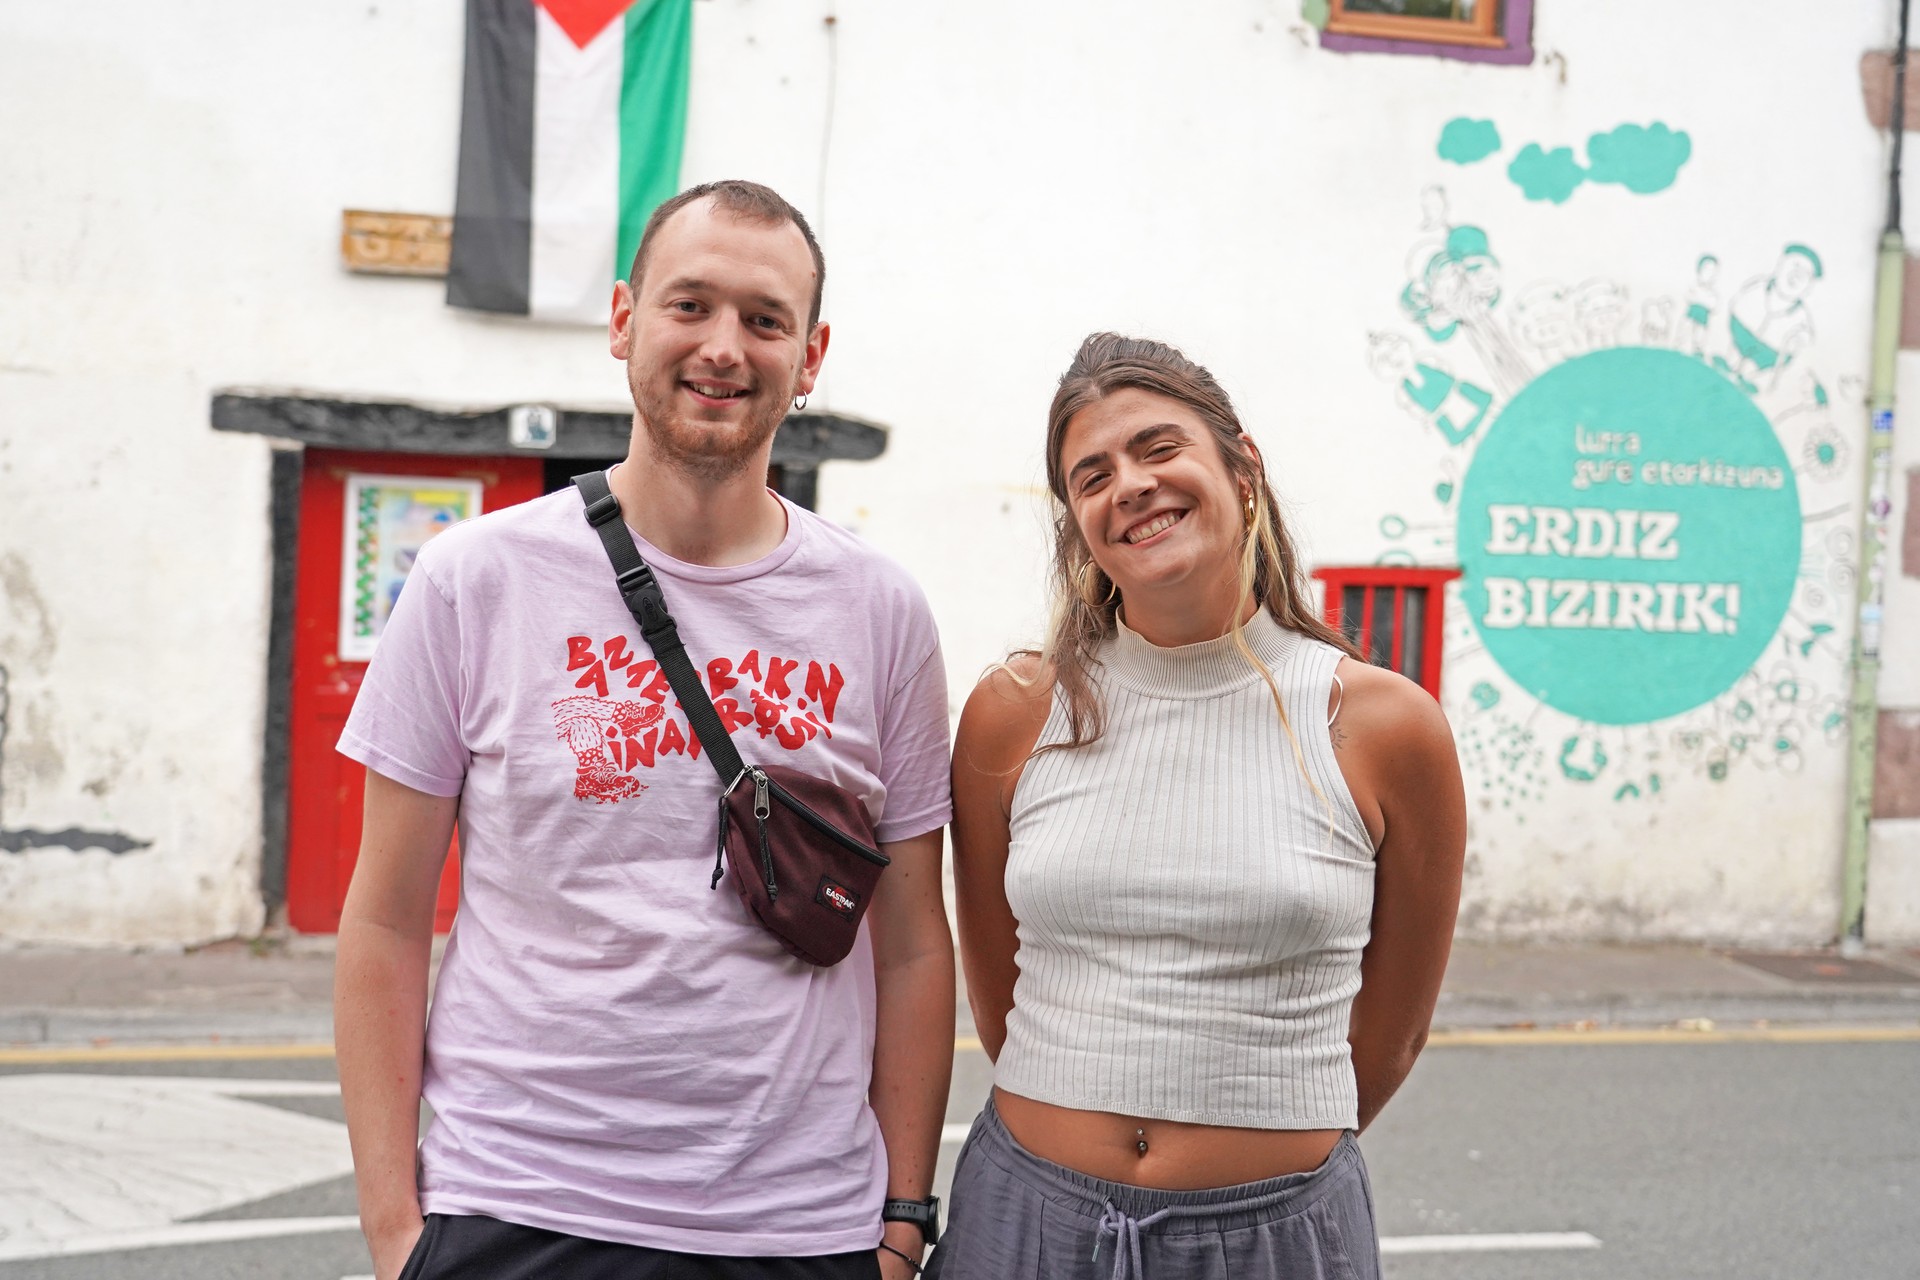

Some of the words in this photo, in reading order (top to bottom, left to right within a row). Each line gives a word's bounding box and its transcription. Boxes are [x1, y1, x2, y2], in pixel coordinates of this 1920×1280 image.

[1575, 424, 1640, 455] lurra
[1572, 459, 1633, 489] gure
[1486, 505, 1679, 559] ERDIZ
[1483, 578, 1739, 633] BIZIRIK!
[825, 887, 854, 909] EASTPAK
